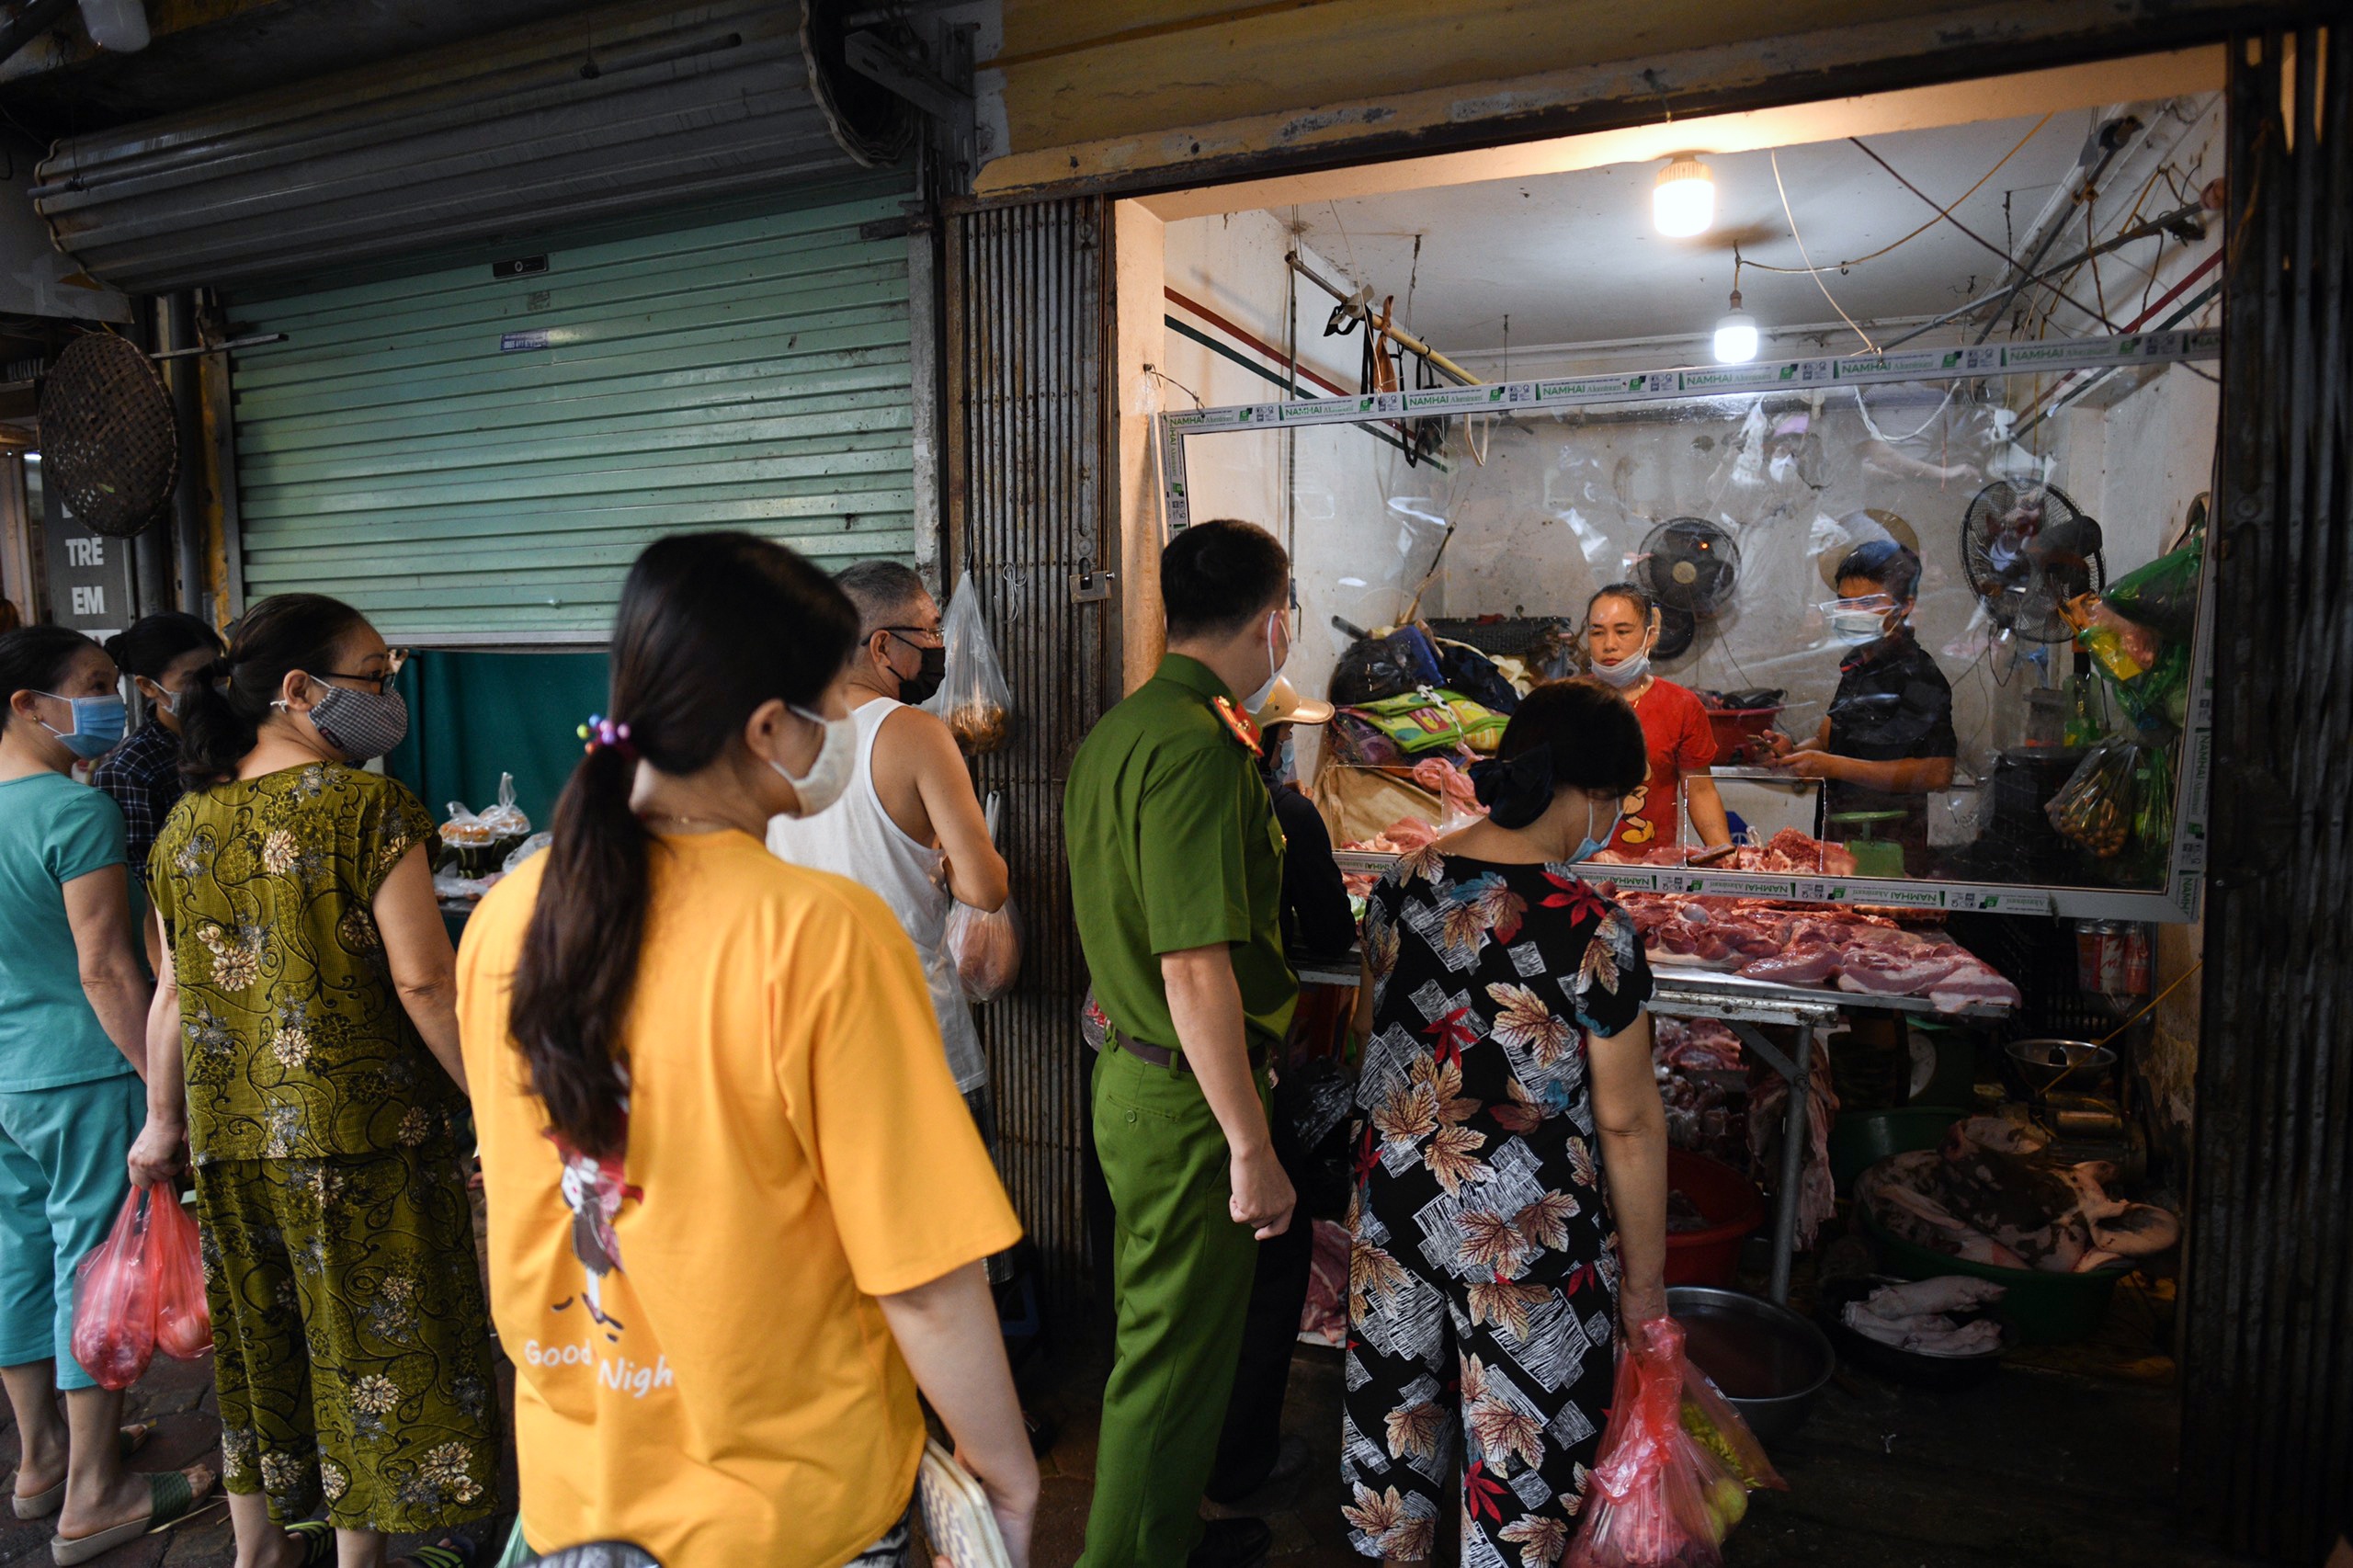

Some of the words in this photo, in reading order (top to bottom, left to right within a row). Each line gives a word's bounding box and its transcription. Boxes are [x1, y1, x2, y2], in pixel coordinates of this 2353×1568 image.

[1842, 361, 1891, 373] NAMHAI
[1687, 374, 1733, 385] NAMHAI
[1543, 384, 1586, 395] NAMHAI
[1409, 395, 1449, 406] NAMHAI
[1285, 406, 1323, 415] NAMHAI
[72, 585, 105, 615] EM
[2196, 735, 2211, 778] NAMHAI
[1610, 876, 1650, 886] NAMHAI
[1745, 883, 1788, 893] NAMHAI
[1891, 892, 1937, 903] NAMHAI
[524, 1338, 593, 1367] Good
[598, 1356, 674, 1398] Nigh
